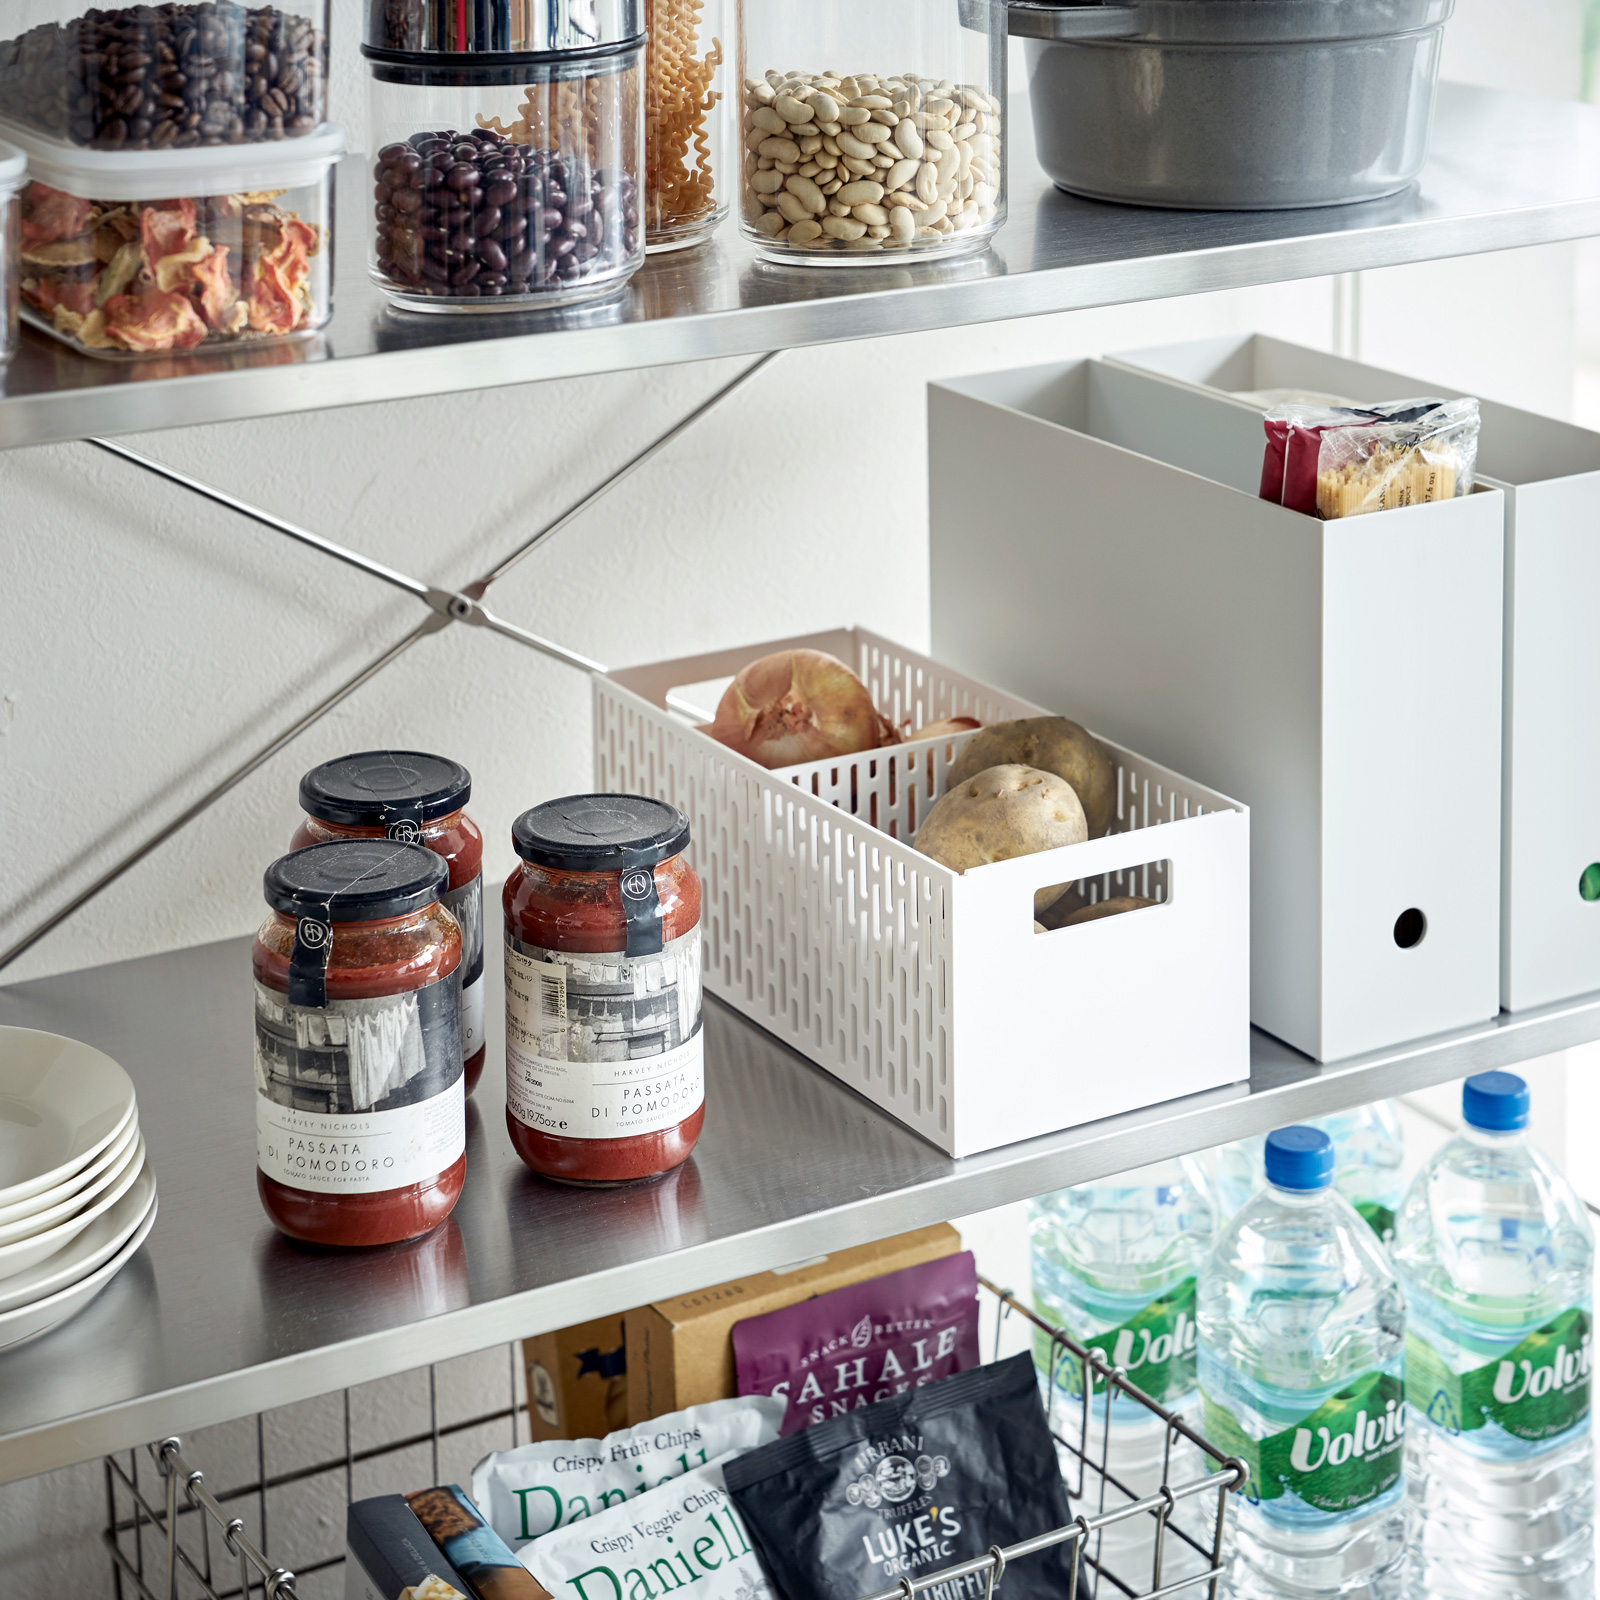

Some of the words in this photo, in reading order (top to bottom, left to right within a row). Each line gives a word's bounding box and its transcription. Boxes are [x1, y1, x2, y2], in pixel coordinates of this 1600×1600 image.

[614, 1066, 652, 1077] HARVEY
[656, 1050, 691, 1069] NICHOLS
[591, 1107, 608, 1118] DI
[621, 1077, 700, 1117] POMODORO
[623, 1073, 686, 1099] PASSATA
[281, 1116, 315, 1128] HARVEY
[320, 1122, 370, 1131] NICHOLS
[616, 1119, 643, 1127] TOMATO
[646, 1113, 665, 1123] SAUCE
[268, 1145, 279, 1160] DI
[287, 1153, 394, 1172] POMODORO
[289, 1137, 361, 1155] PASSATA
[283, 1168, 306, 1179] TOMATO
[308, 1175, 330, 1183] SAUCE
[800, 1335, 849, 1368] SNACK
[874, 1319, 932, 1335] BETTER
[771, 1326, 957, 1404] SAHALE
[811, 1373, 930, 1424] SNACKS
[553, 1455, 605, 1474] Crispy
[610, 1441, 650, 1463] Fruit
[654, 1426, 702, 1451] Chips
[855, 1436, 924, 1469] URBANI
[590, 1530, 635, 1556] Crispy
[632, 1509, 683, 1538] Veggie
[682, 1485, 728, 1514] Chips
[878, 1492, 934, 1520] TRUFFLES
[400, 1537, 422, 1560] DELUCA
[862, 1506, 962, 1564] LUKE'S
[565, 1505, 753, 1600] Daniell
[883, 1541, 954, 1577] ORGANIC
[922, 1568, 1000, 1600] TRUFFL
